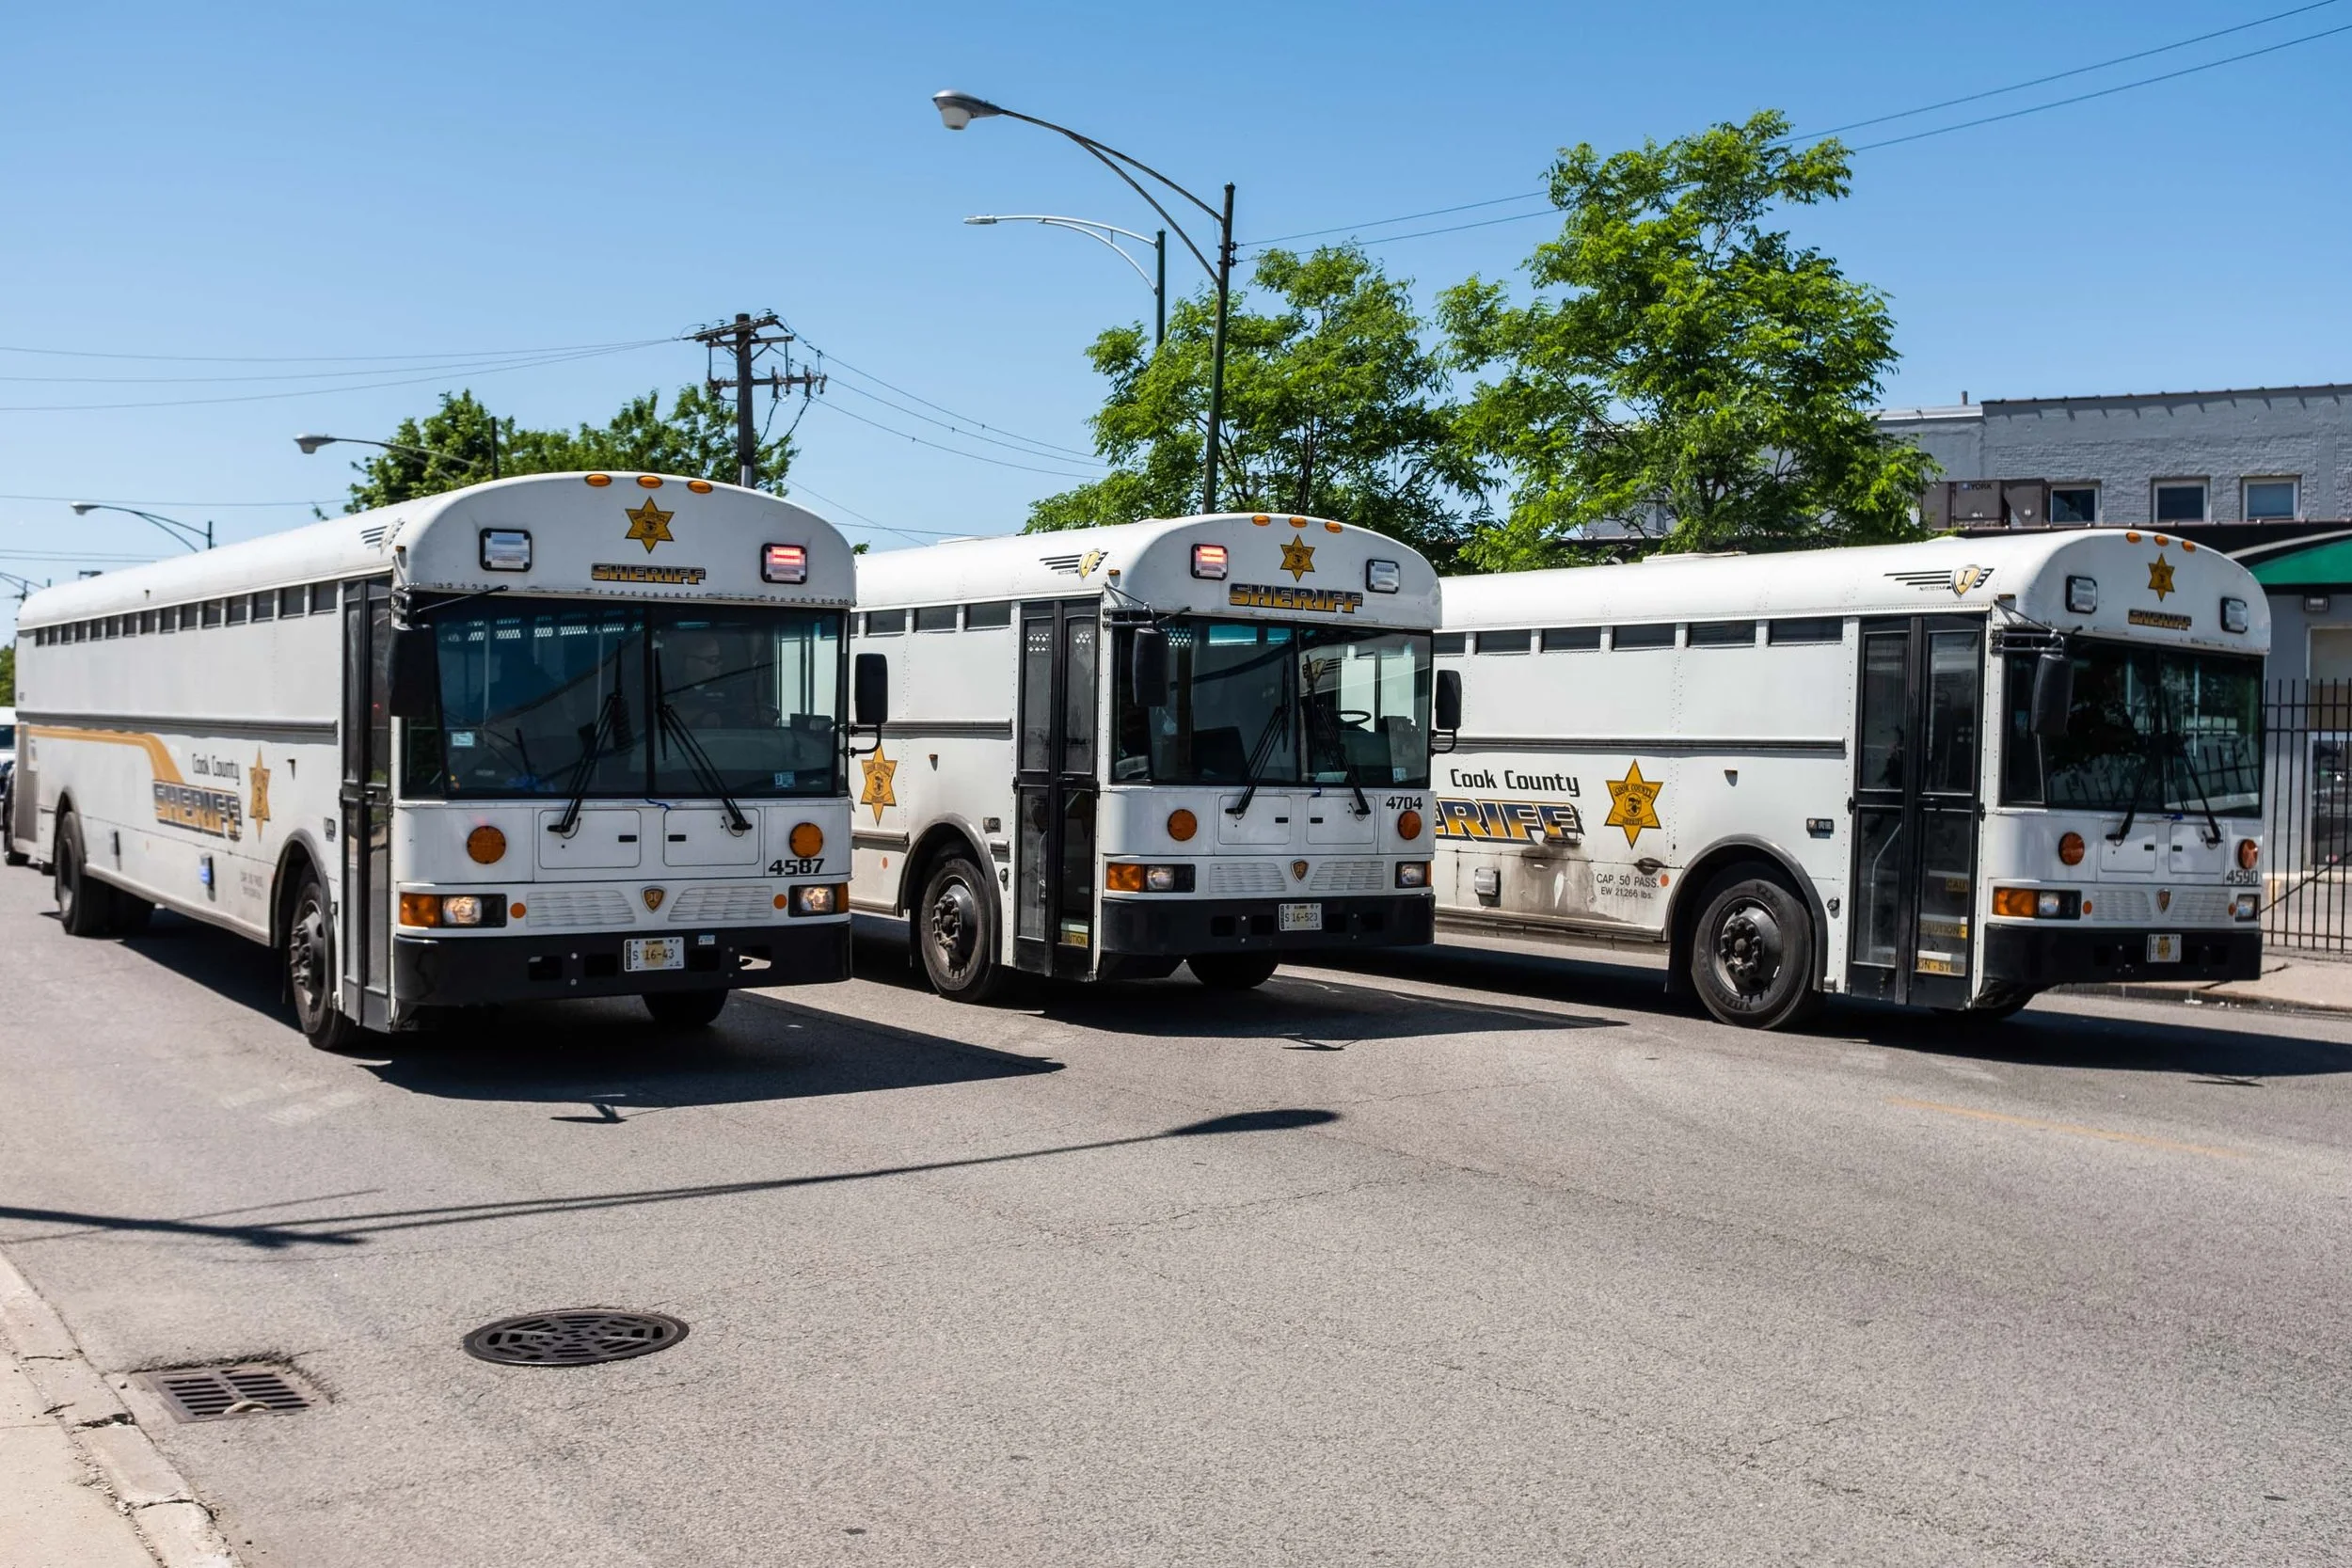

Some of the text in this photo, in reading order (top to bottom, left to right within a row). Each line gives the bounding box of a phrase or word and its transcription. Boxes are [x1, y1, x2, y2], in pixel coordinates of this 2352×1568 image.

[592, 562, 707, 585] SHERIFF
[1229, 582, 1363, 613] SHERIFF
[193, 753, 241, 786] Cook County
[1450, 768, 1581, 798] Cook County
[152, 779, 242, 842] SHERIFF
[1386, 796, 1422, 810] 4704
[1436, 798, 1585, 845] RIFF
[769, 858, 824, 875] 4587
[2226, 869, 2259, 884] 4590
[1600, 887, 1613, 895] EW
[1619, 875, 1631, 886] 50
[1634, 877, 1660, 889] PASS.
